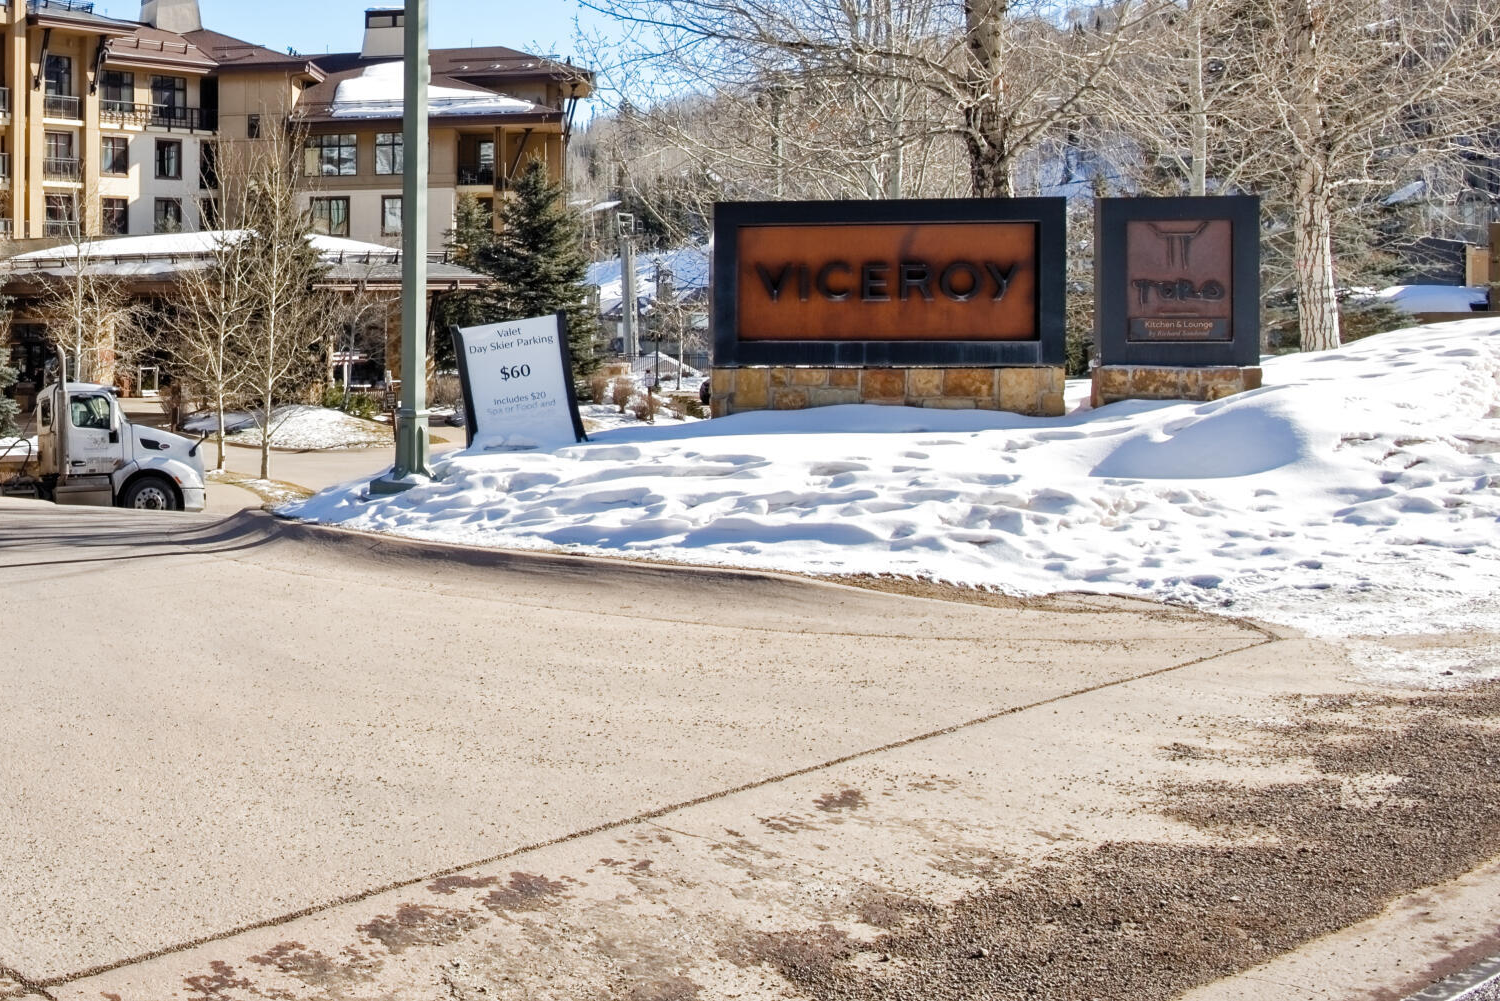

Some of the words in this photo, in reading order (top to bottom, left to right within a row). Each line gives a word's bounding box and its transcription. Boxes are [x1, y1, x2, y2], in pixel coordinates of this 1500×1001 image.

[755, 260, 1020, 302] VICEROY
[1144, 321, 1175, 329] Kitchen
[1184, 321, 1213, 330] Lounge
[497, 328, 521, 338] Valet
[469, 345, 488, 354] Day
[490, 341, 514, 351] Skier
[516, 336, 553, 346] Parking
[500, 364, 531, 381] $60
[494, 394, 529, 405] Includes
[531, 391, 546, 400] $20
[541, 399, 556, 408] and
